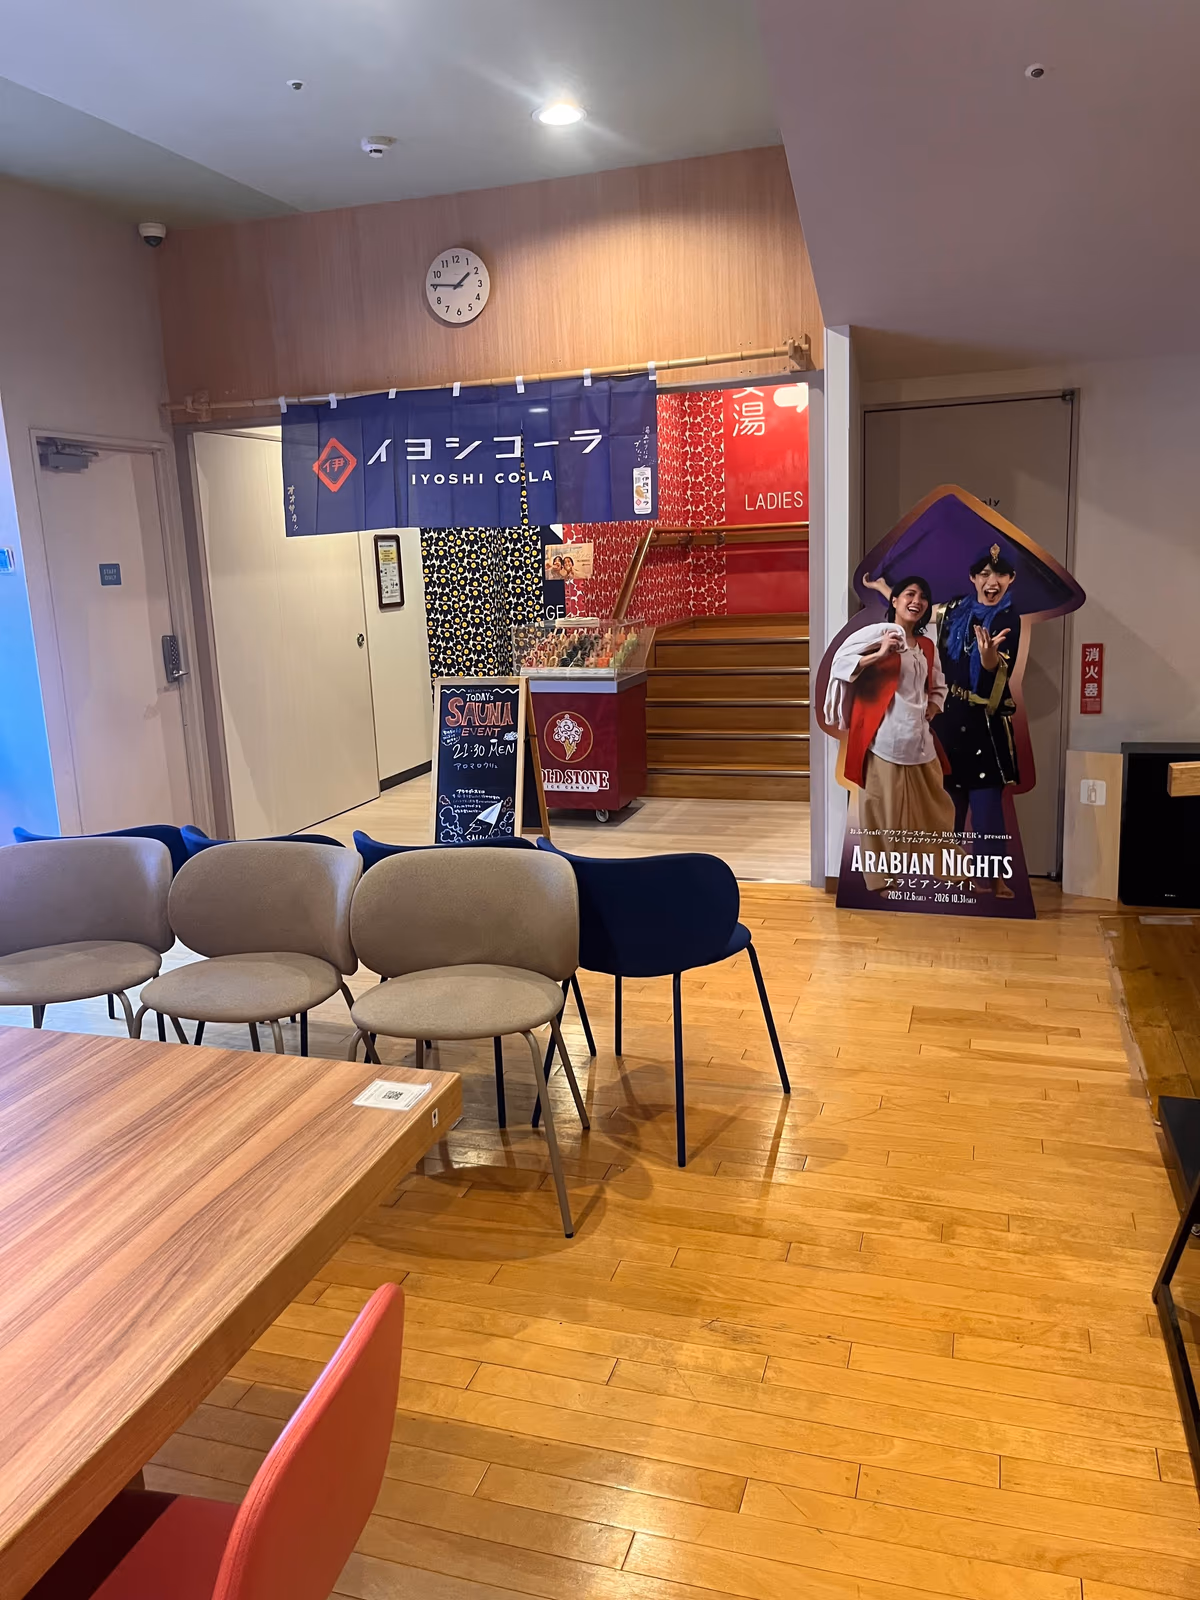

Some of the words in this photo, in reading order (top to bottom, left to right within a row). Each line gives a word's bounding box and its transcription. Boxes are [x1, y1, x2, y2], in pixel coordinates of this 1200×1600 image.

[441, 260, 449, 268] 11
[452, 255, 460, 264] 12
[466, 258, 469, 266] 1
[433, 270, 442, 279] 10
[474, 267, 479, 275] 2
[478, 280, 483, 288] 3
[436, 297, 442, 305] 8
[475, 293, 481, 301] 4
[445, 305, 450, 313] 7
[468, 303, 473, 311] 5
[456, 308, 462, 316] 6
[367, 429, 602, 465] イヨシコーラ
[411, 473, 483, 485] IYOSHI
[494, 470, 553, 484] COLA
[745, 491, 804, 511] LADIES
[1084, 647, 1100, 697] 消火器
[445, 697, 514, 727] SAUNA
[461, 728, 501, 737] EVENT
[452, 743, 485, 759] 21:30
[488, 742, 515, 757] MEN
[942, 831, 982, 839] ROASTER's
[851, 845, 935, 876] ARABIAN
[941, 848, 1013, 879] NIGHTS
[884, 878, 976, 892] アラビアンナイト
[888, 890, 902, 900] 2025
[934, 893, 950, 903] 2026
